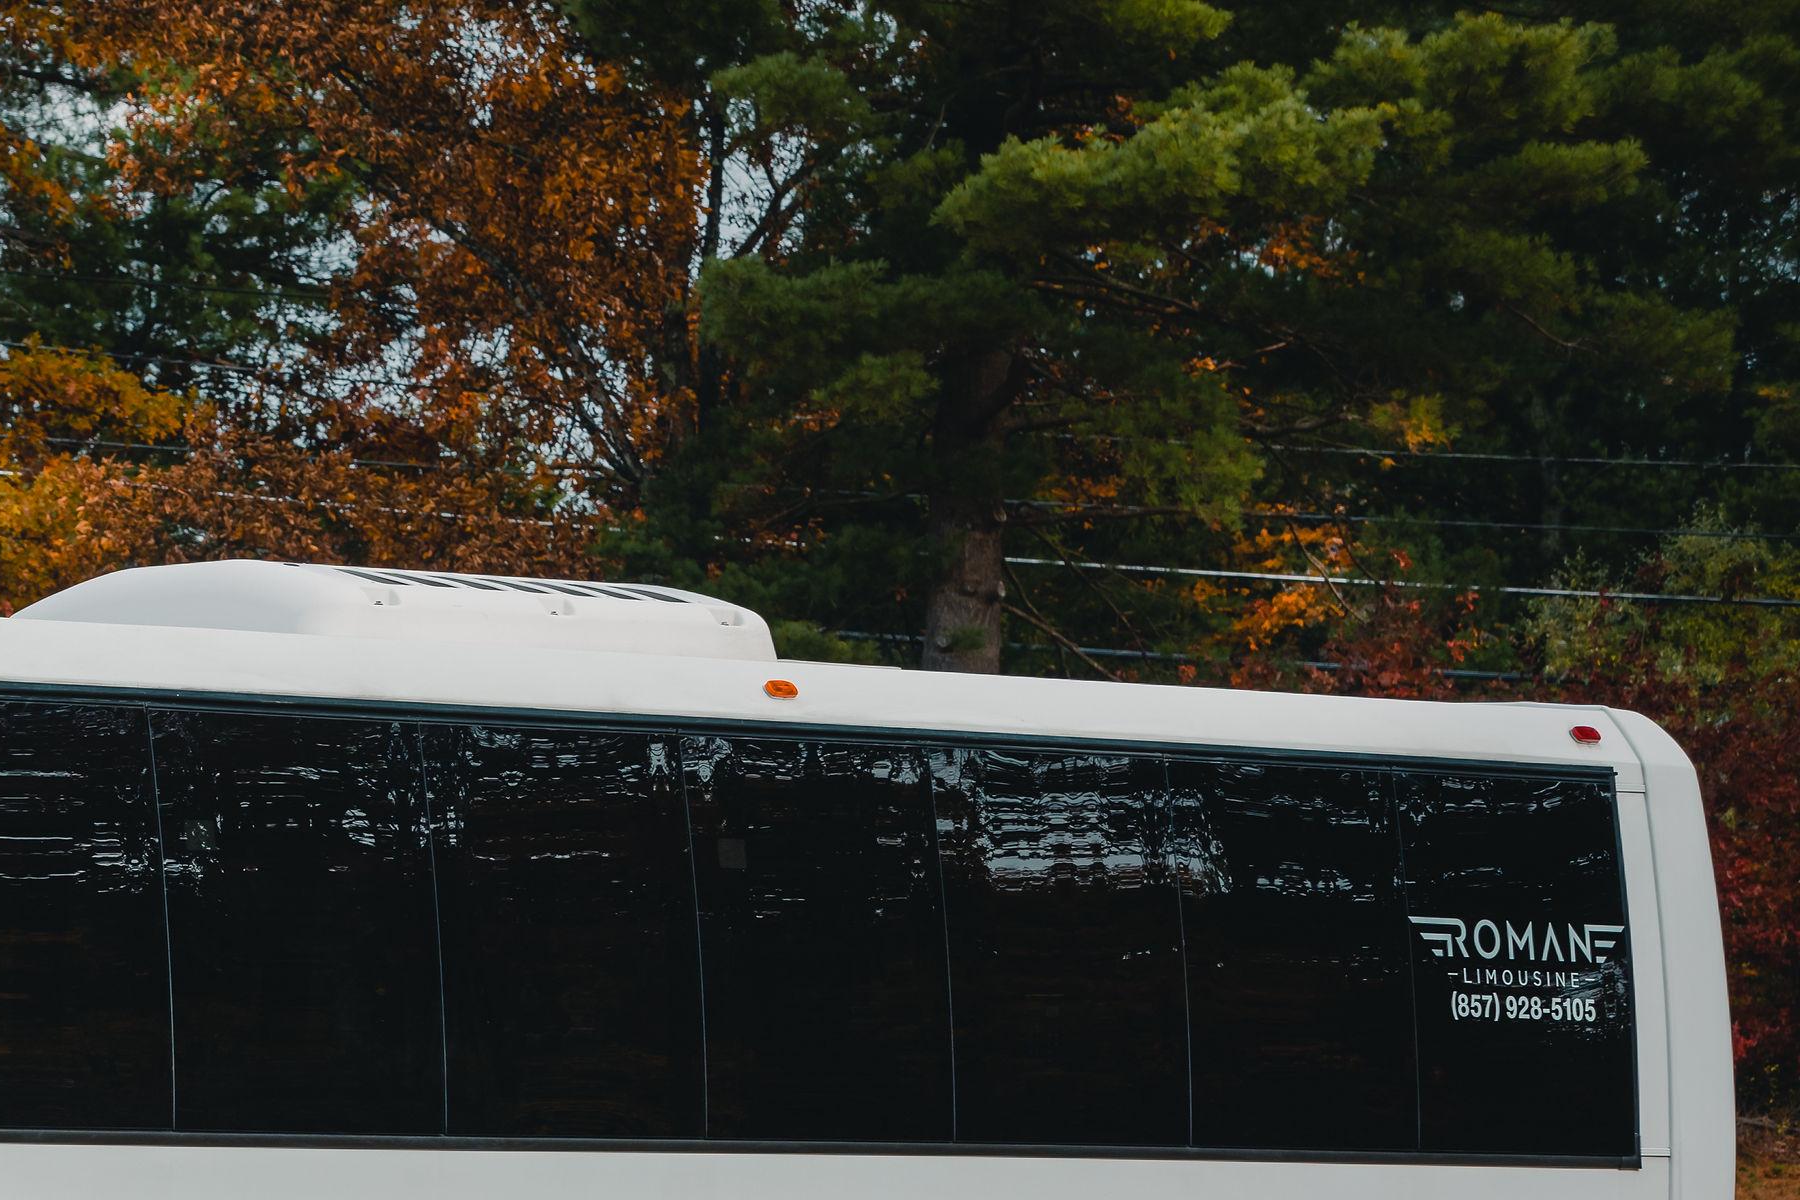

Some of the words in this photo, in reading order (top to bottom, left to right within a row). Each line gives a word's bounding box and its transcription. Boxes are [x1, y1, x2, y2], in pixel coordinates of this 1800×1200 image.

[1408, 916, 1625, 964] ROMAN
[1462, 968, 1580, 988] LIMOUSINE
[1451, 991, 1500, 1022] (857)
[1506, 995, 1597, 1022] 928-5105
